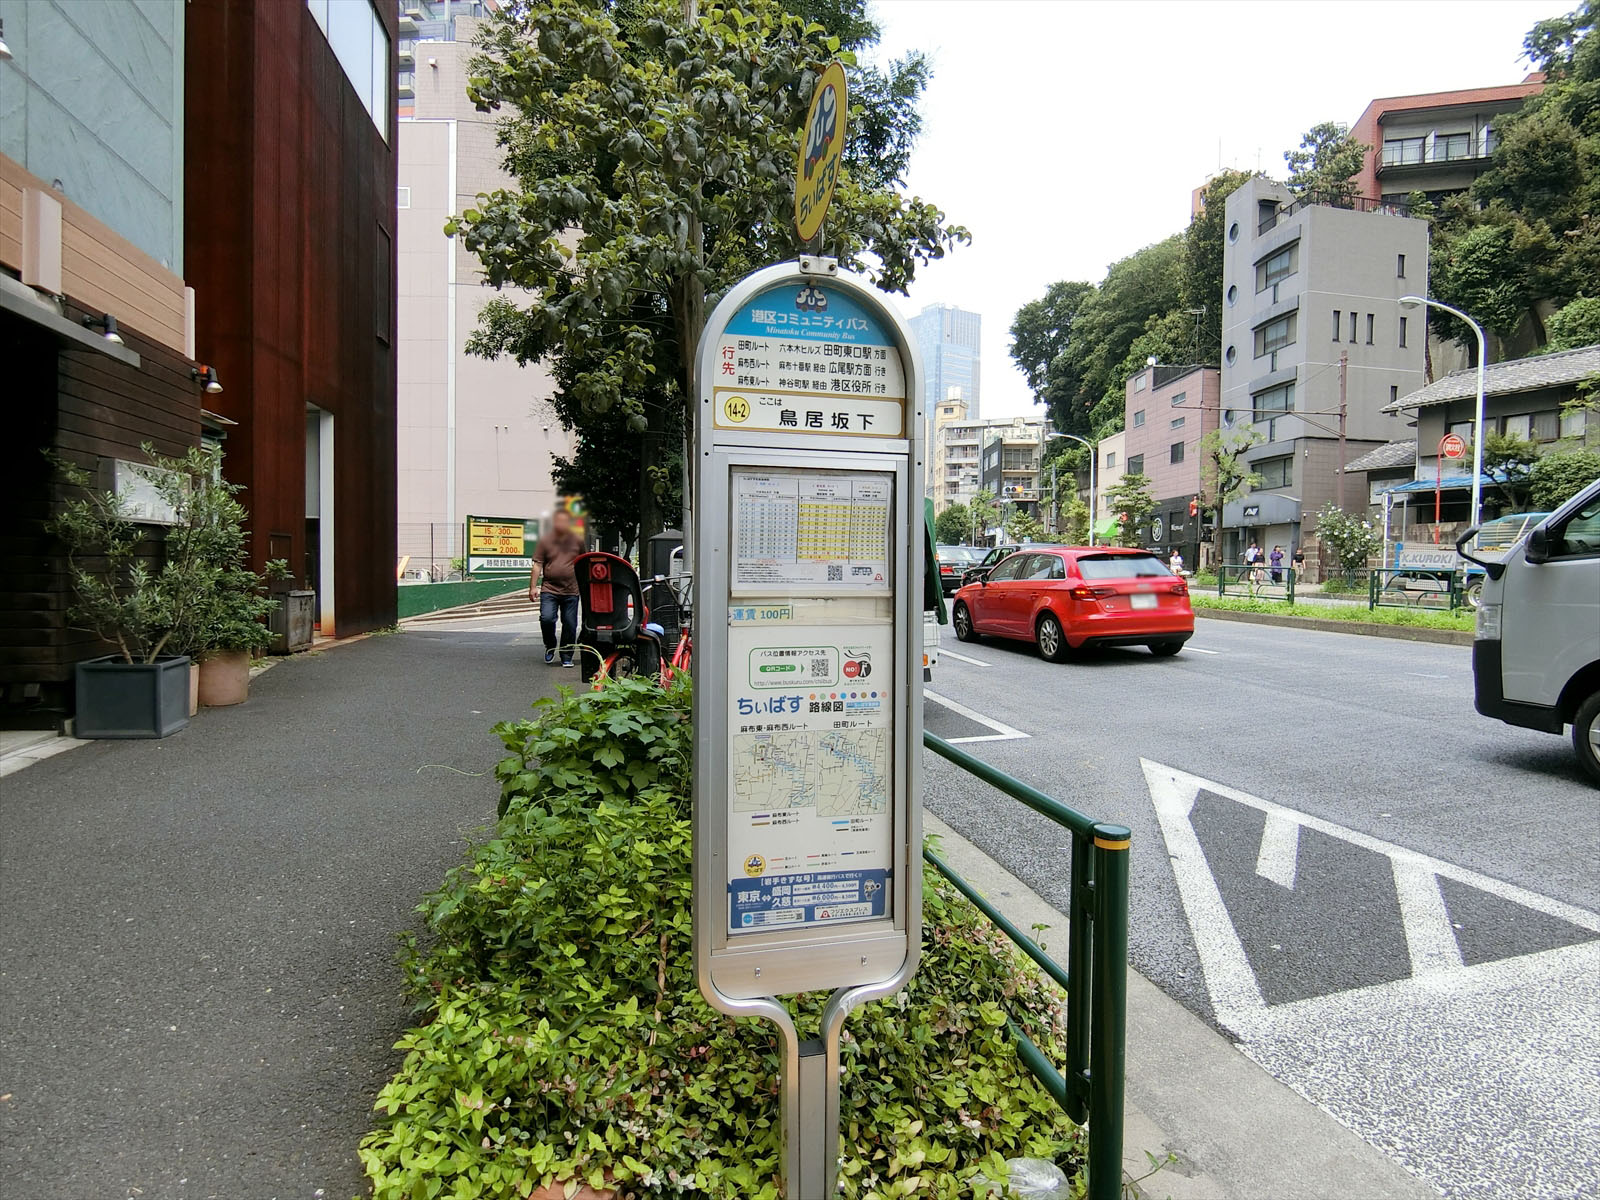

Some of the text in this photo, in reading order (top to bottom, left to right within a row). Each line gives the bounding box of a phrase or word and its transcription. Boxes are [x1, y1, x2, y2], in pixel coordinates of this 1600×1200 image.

[751, 309, 869, 331] 港区コミュニティバス
[765, 326, 856, 340] Minatoku Community Bus
[738, 340, 887, 360] 田町ルート 六本木ヒルズ 田町東口駅 方面
[722, 345, 735, 375] 行先
[737, 358, 770, 369] 麻布西ルート
[813, 363, 826, 373] 経由
[829, 361, 872, 377] 広尾駅方面
[874, 366, 886, 377] 行き
[737, 375, 886, 394] 麻布東ルート 神谷町駅 経由 港区役所 行き
[759, 397, 782, 406] ここは
[728, 402, 746, 418] 14-2
[778, 408, 875, 431] 鳥居坂下
[486, 559, 534, 568] 時間貸駐車場入
[1401, 553, 1453, 564] K.KUROKI
[733, 608, 790, 621] 運賃 100円
[737, 695, 804, 716] ちぃばす
[809, 701, 844, 713] 路線図
[833, 720, 873, 729] 田町ルート
[737, 890, 761, 903] 東京
